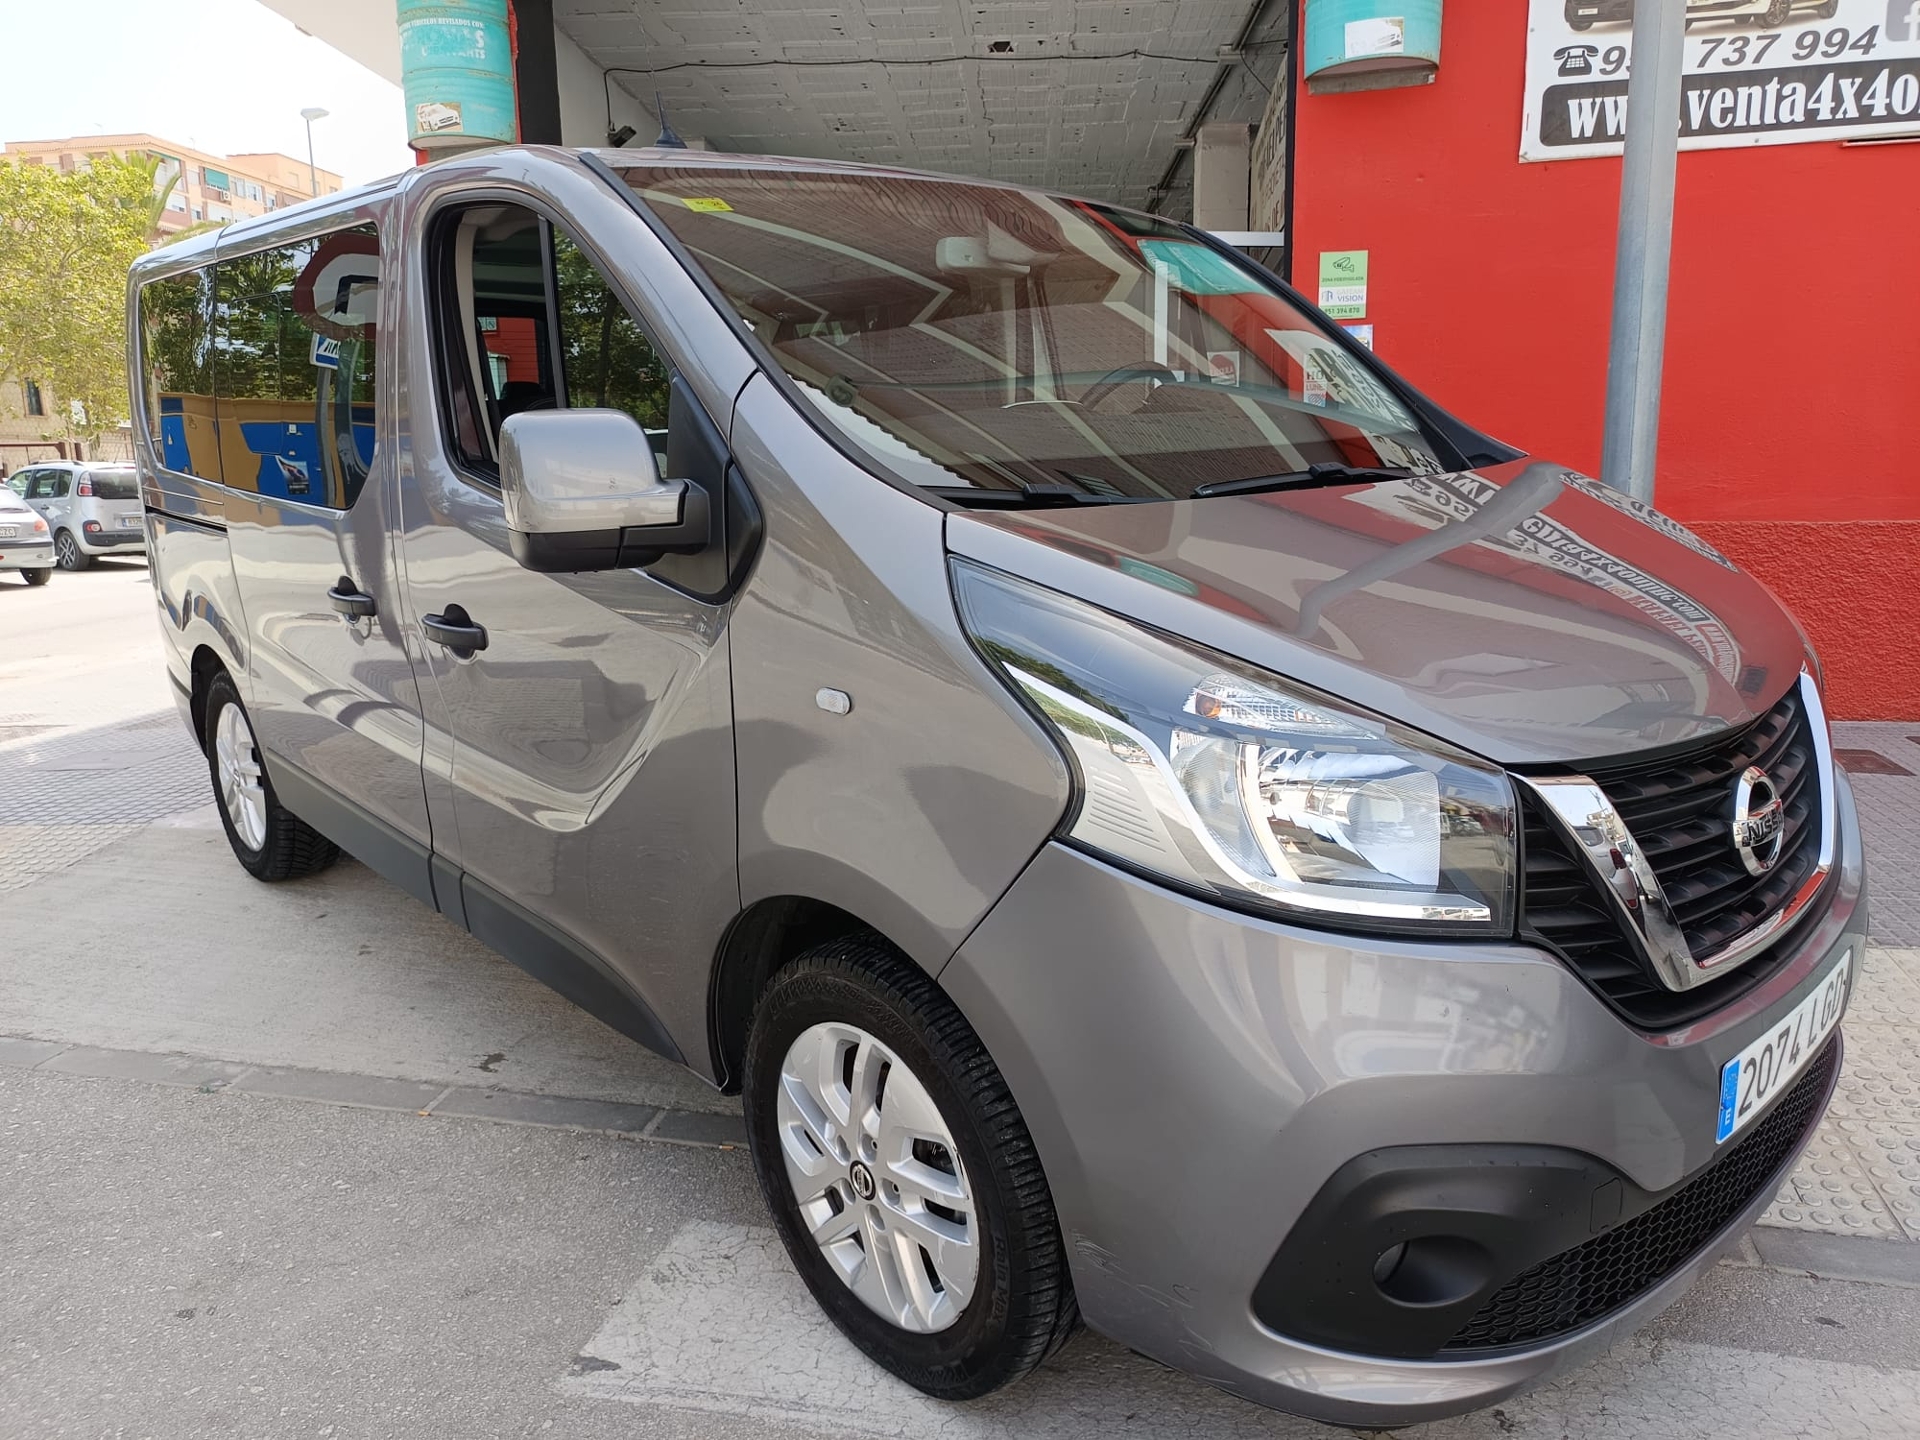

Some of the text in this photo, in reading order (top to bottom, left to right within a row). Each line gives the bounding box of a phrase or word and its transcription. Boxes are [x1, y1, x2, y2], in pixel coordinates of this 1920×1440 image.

[1696, 33, 1782, 70] 737
[1791, 25, 1881, 61] 994
[1337, 294, 1364, 302] VISION
[1738, 967, 1845, 1119] 2074 LGD
